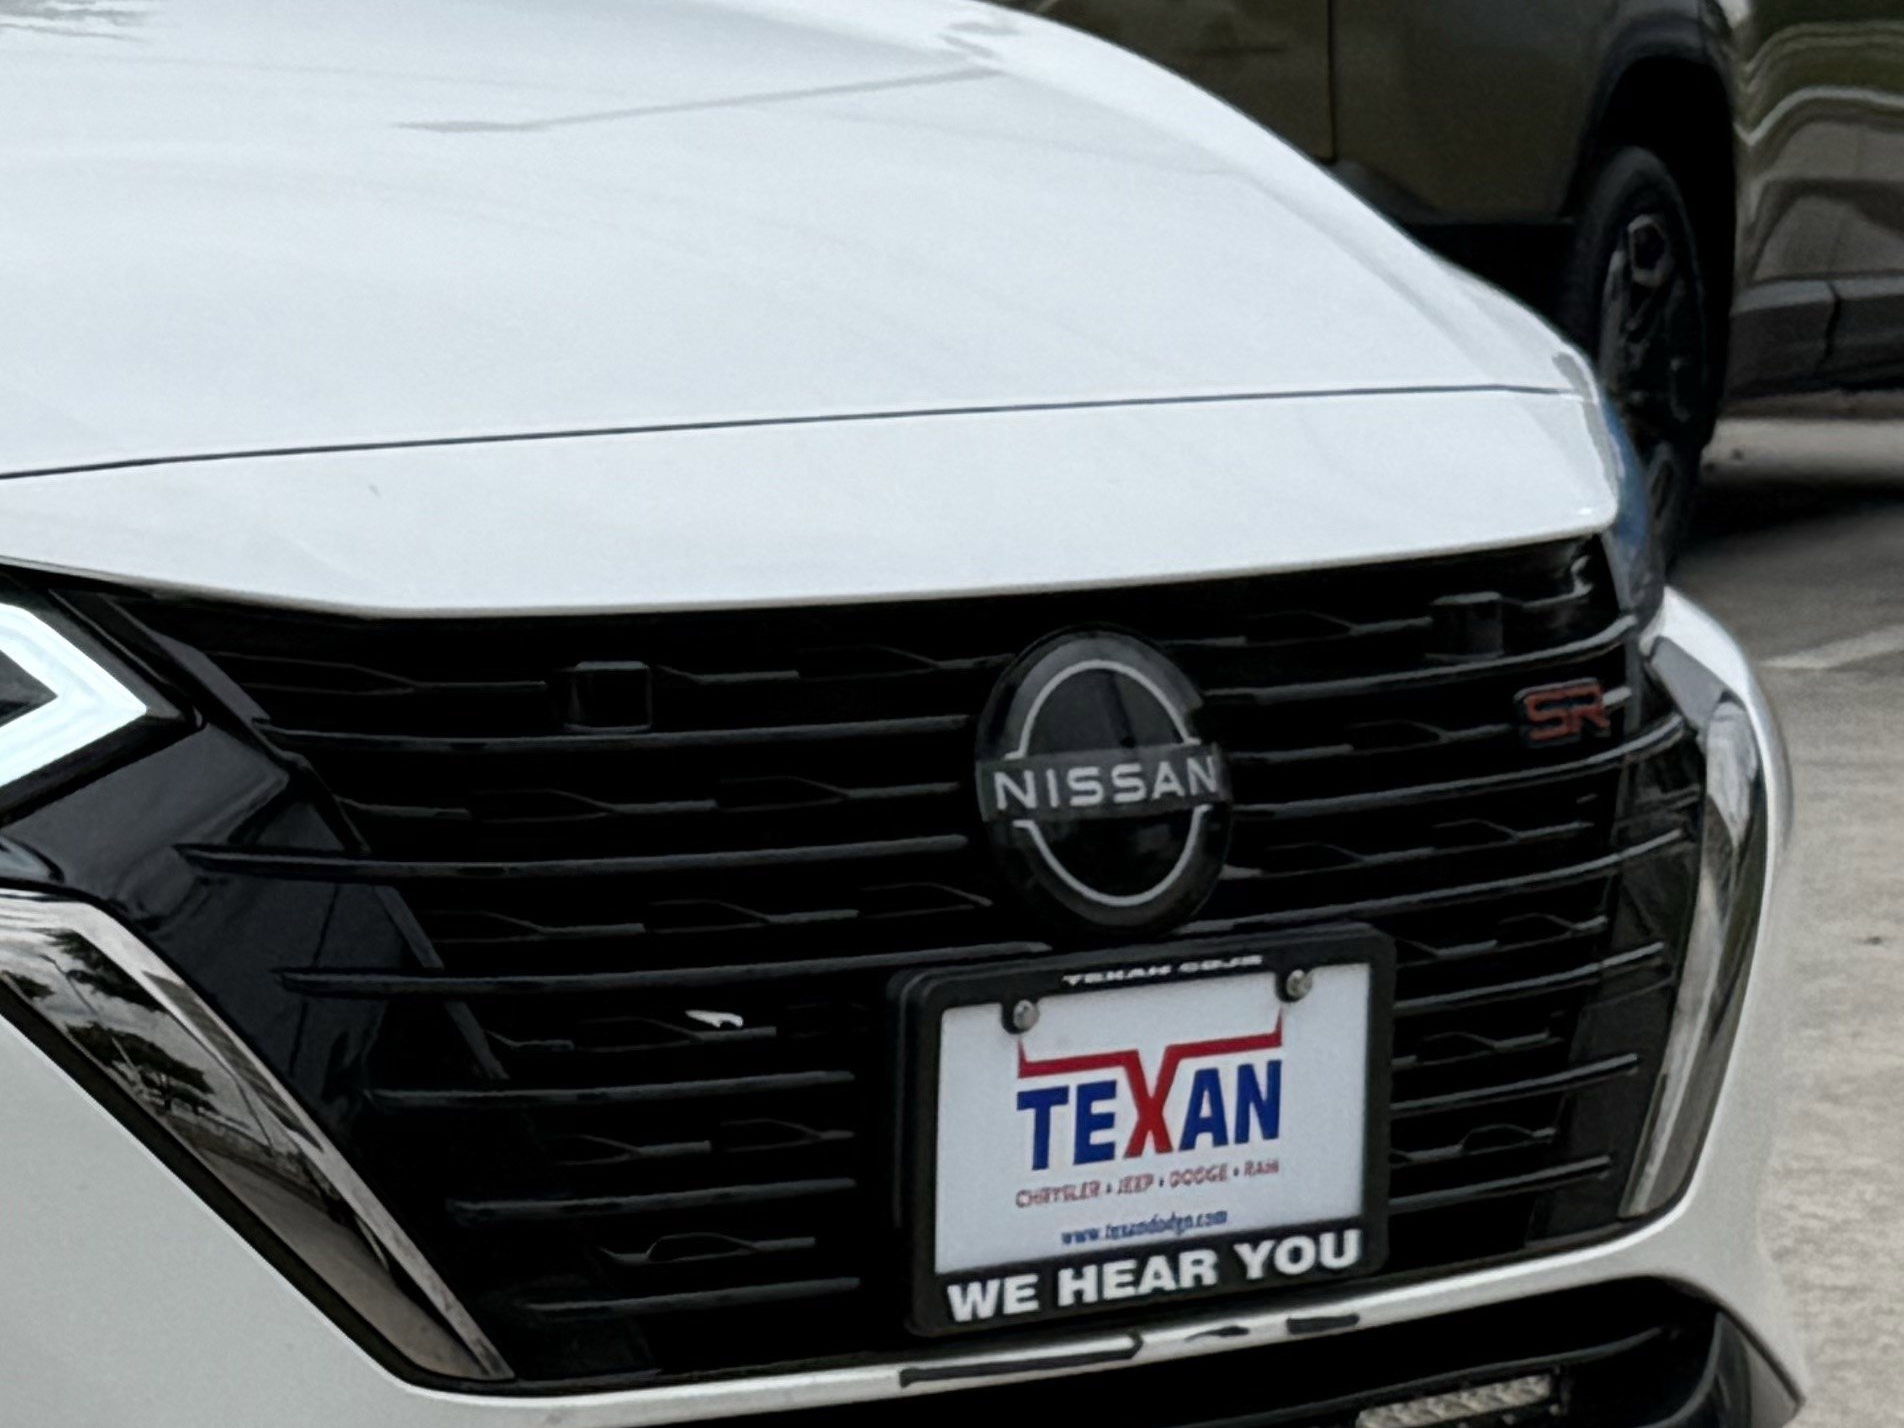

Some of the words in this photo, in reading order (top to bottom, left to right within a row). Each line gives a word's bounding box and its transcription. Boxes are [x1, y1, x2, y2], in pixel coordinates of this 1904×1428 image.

[1523, 682, 1611, 741] SR
[994, 755, 1218, 810] NISSAN
[1016, 1027, 1283, 1171] TEXAN
[1015, 1178, 1101, 1209] CHRYSLER
[1168, 1162, 1229, 1189] DODGE
[1243, 1158, 1281, 1177] RAM
[947, 1273, 1040, 1323] WE
[1057, 1248, 1218, 1308] HEAR
[1234, 1228, 1362, 1280] YOU
